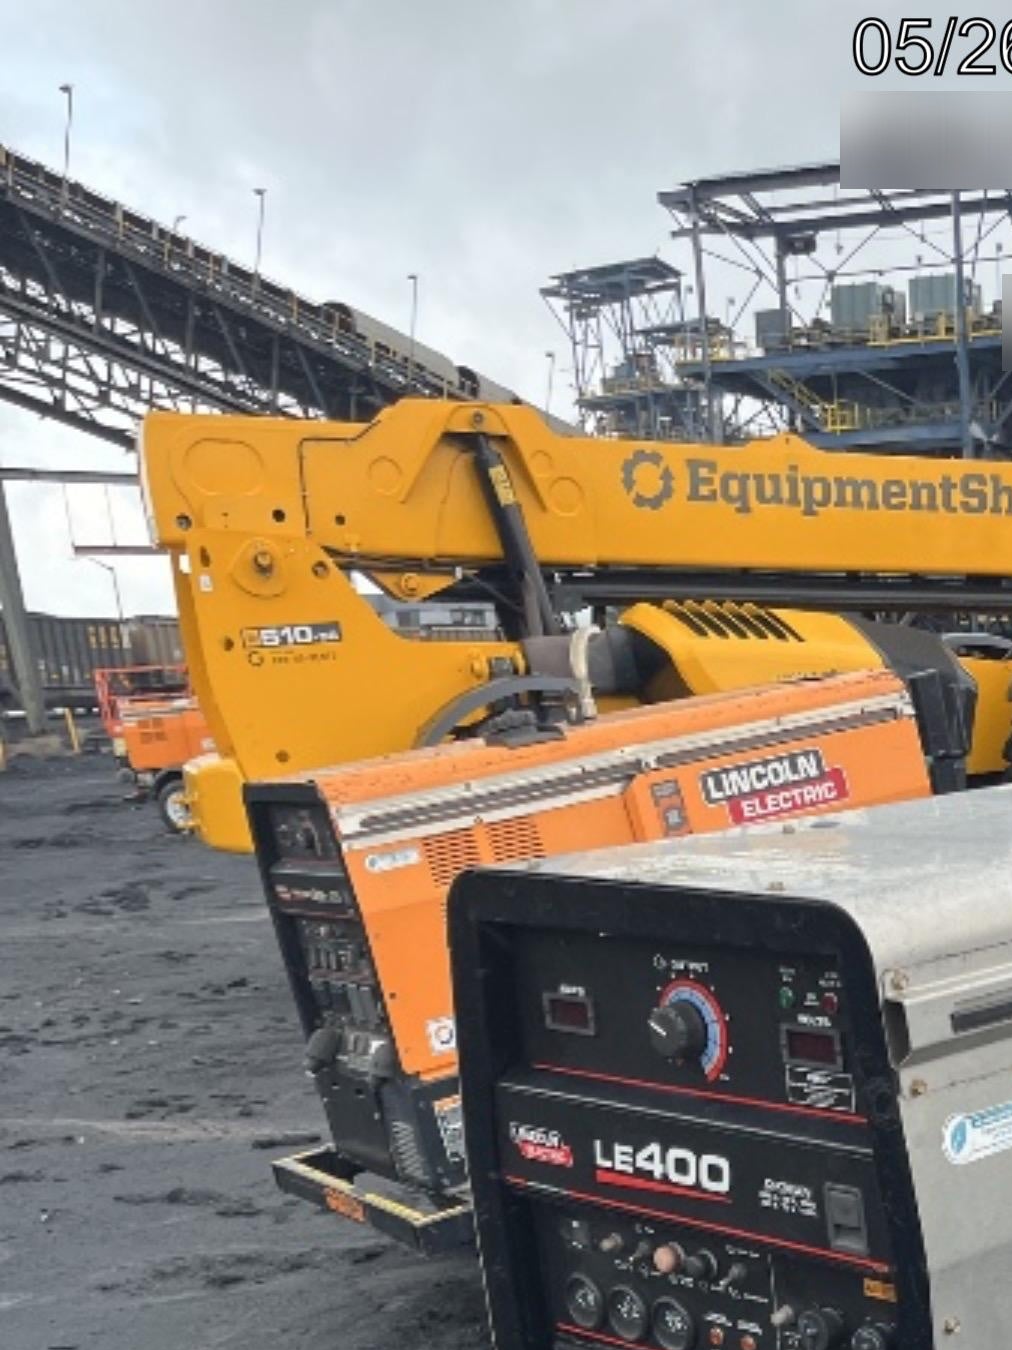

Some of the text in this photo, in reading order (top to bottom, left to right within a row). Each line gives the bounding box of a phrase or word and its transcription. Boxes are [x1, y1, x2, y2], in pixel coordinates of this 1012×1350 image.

[706, 752, 820, 799] LINCOLN
[740, 781, 838, 818] ELECTRIC
[593, 1138, 731, 1193] LE400
